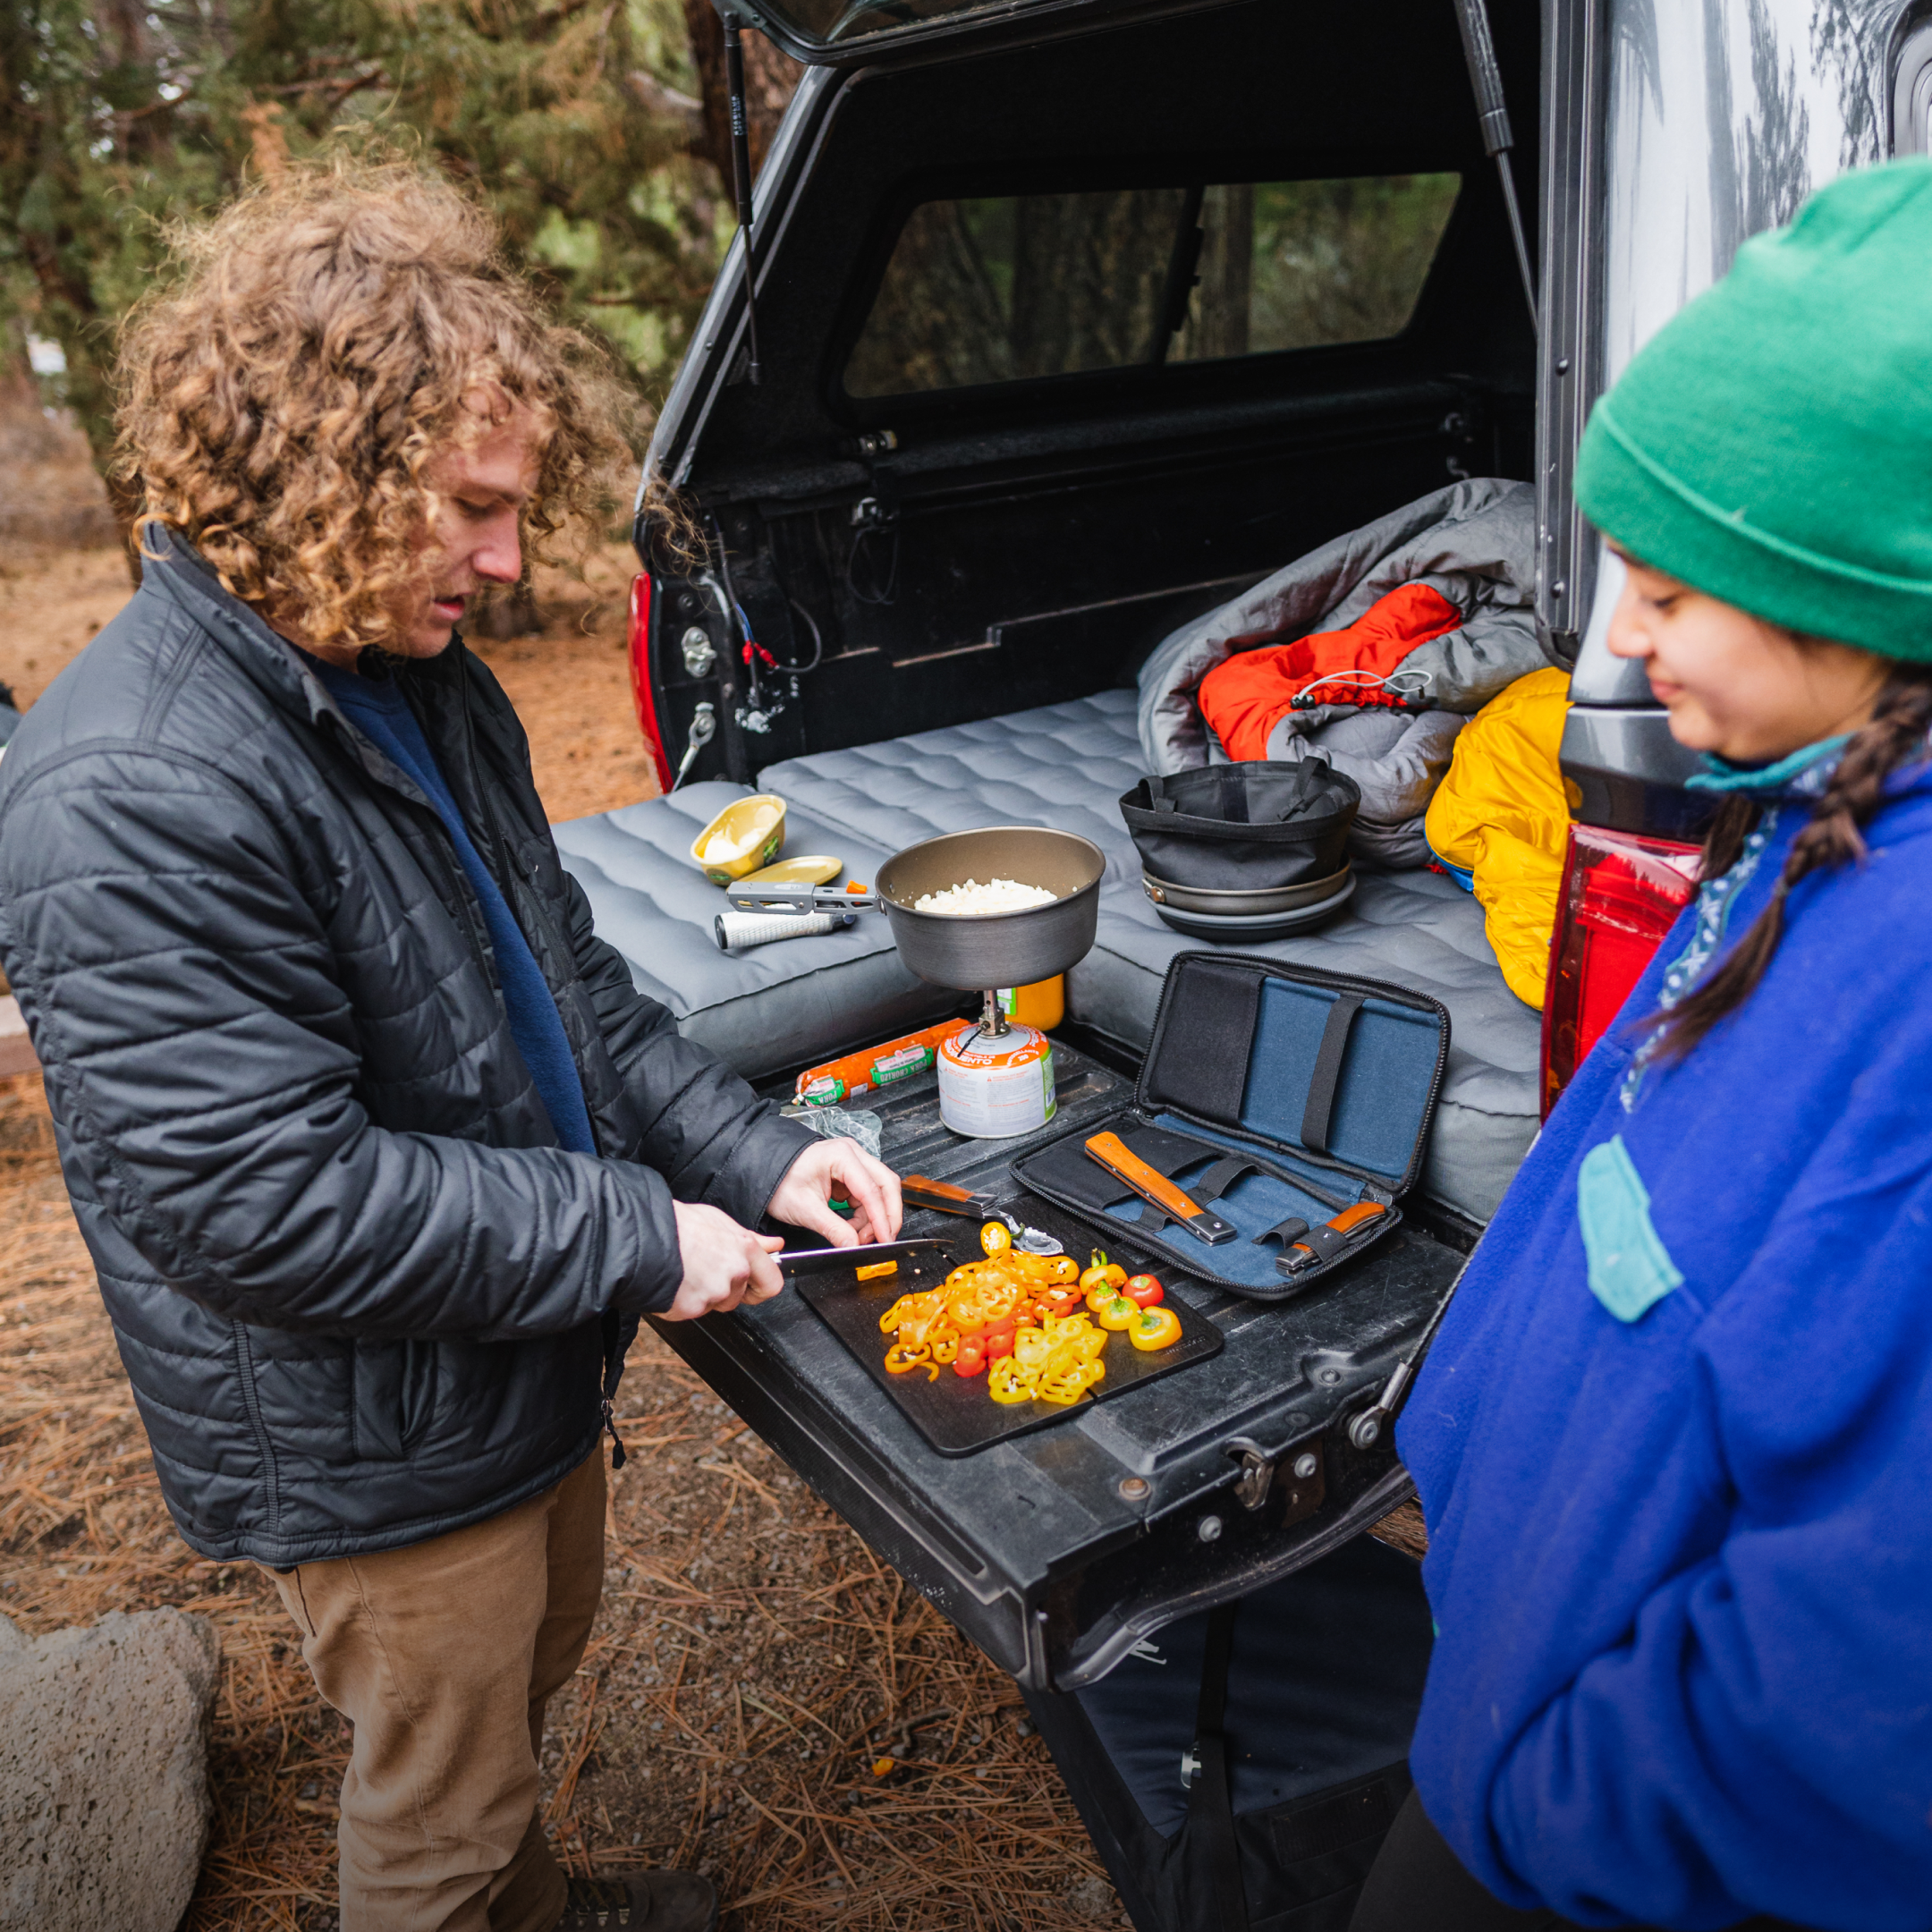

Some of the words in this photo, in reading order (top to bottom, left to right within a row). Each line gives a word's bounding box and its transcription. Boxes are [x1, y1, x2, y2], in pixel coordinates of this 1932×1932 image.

[910, 1059, 928, 1072] PORK
[880, 1068, 909, 1082] CHORIZO
[818, 1090, 837, 1105] PORK
